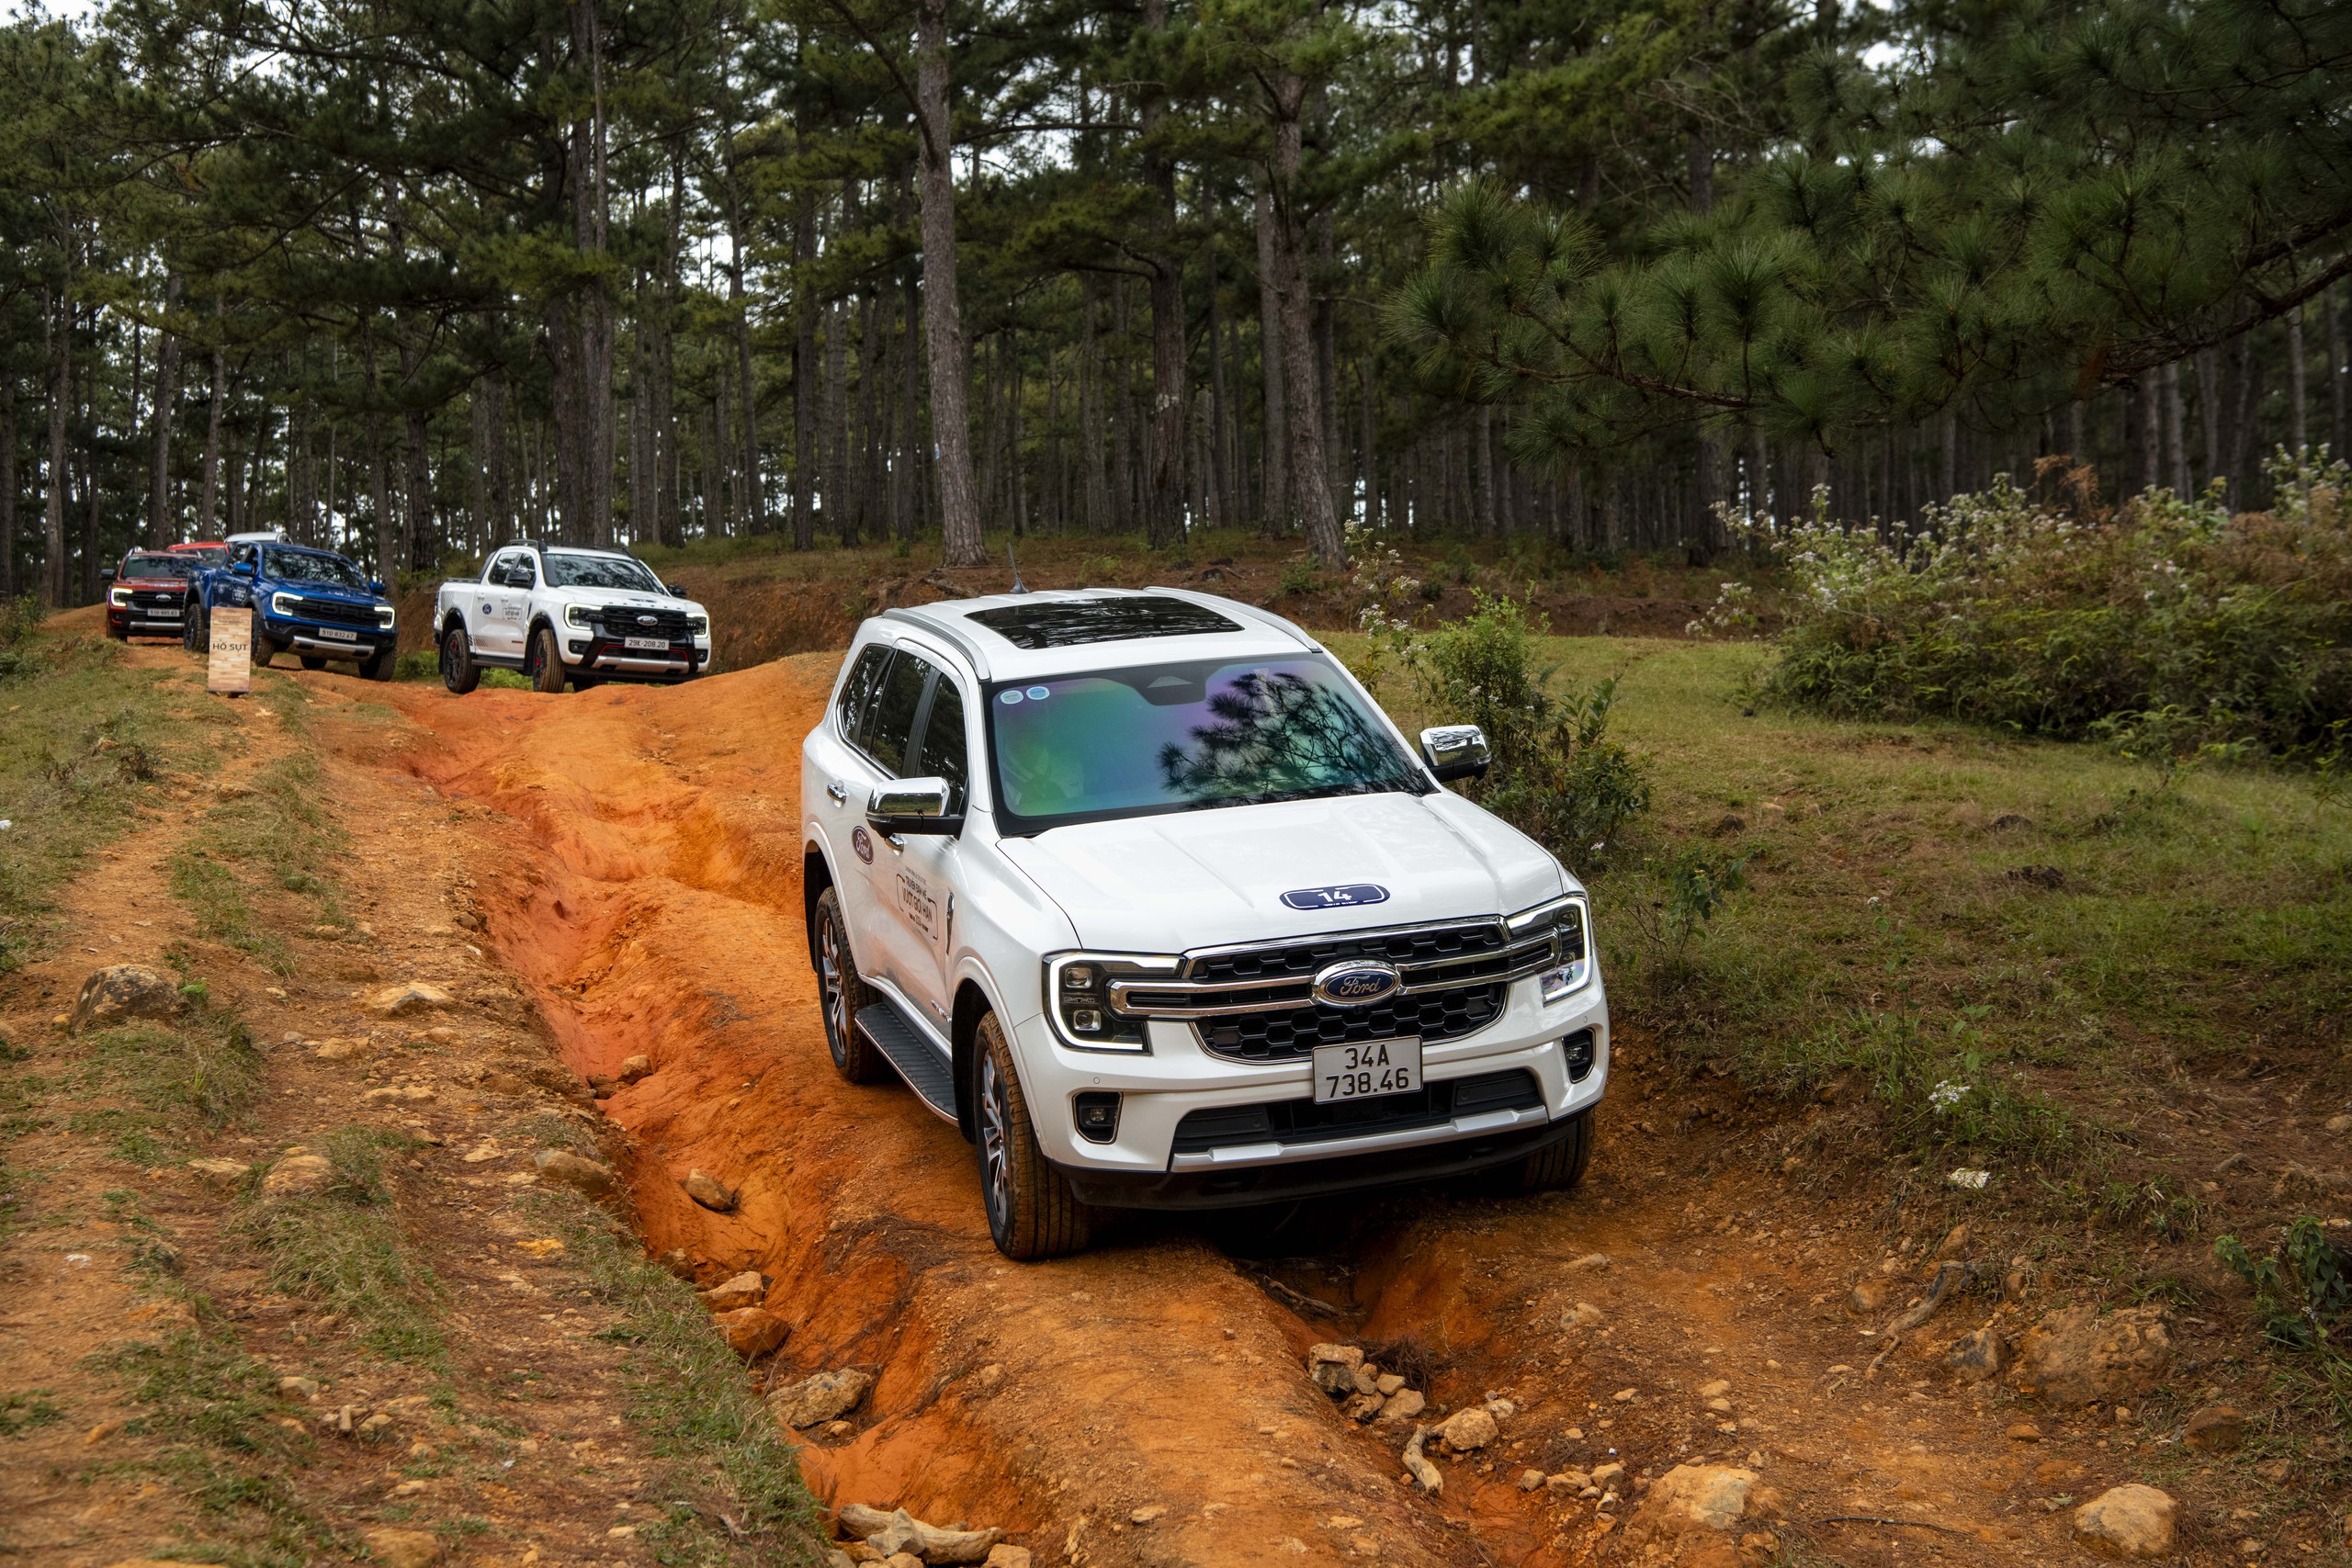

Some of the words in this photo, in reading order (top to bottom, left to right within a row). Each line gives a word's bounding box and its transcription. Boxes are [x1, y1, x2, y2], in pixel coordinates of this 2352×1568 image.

[212, 640, 227, 650] HỐ
[230, 643, 248, 653] SỤT
[628, 638, 666, 649] 29K-208.20
[855, 830, 870, 859] Ford
[1317, 891, 1352, 903] 14
[1340, 975, 1381, 996] Ford
[1344, 1043, 1390, 1070] 34A
[1326, 1066, 1409, 1099] 738.46
